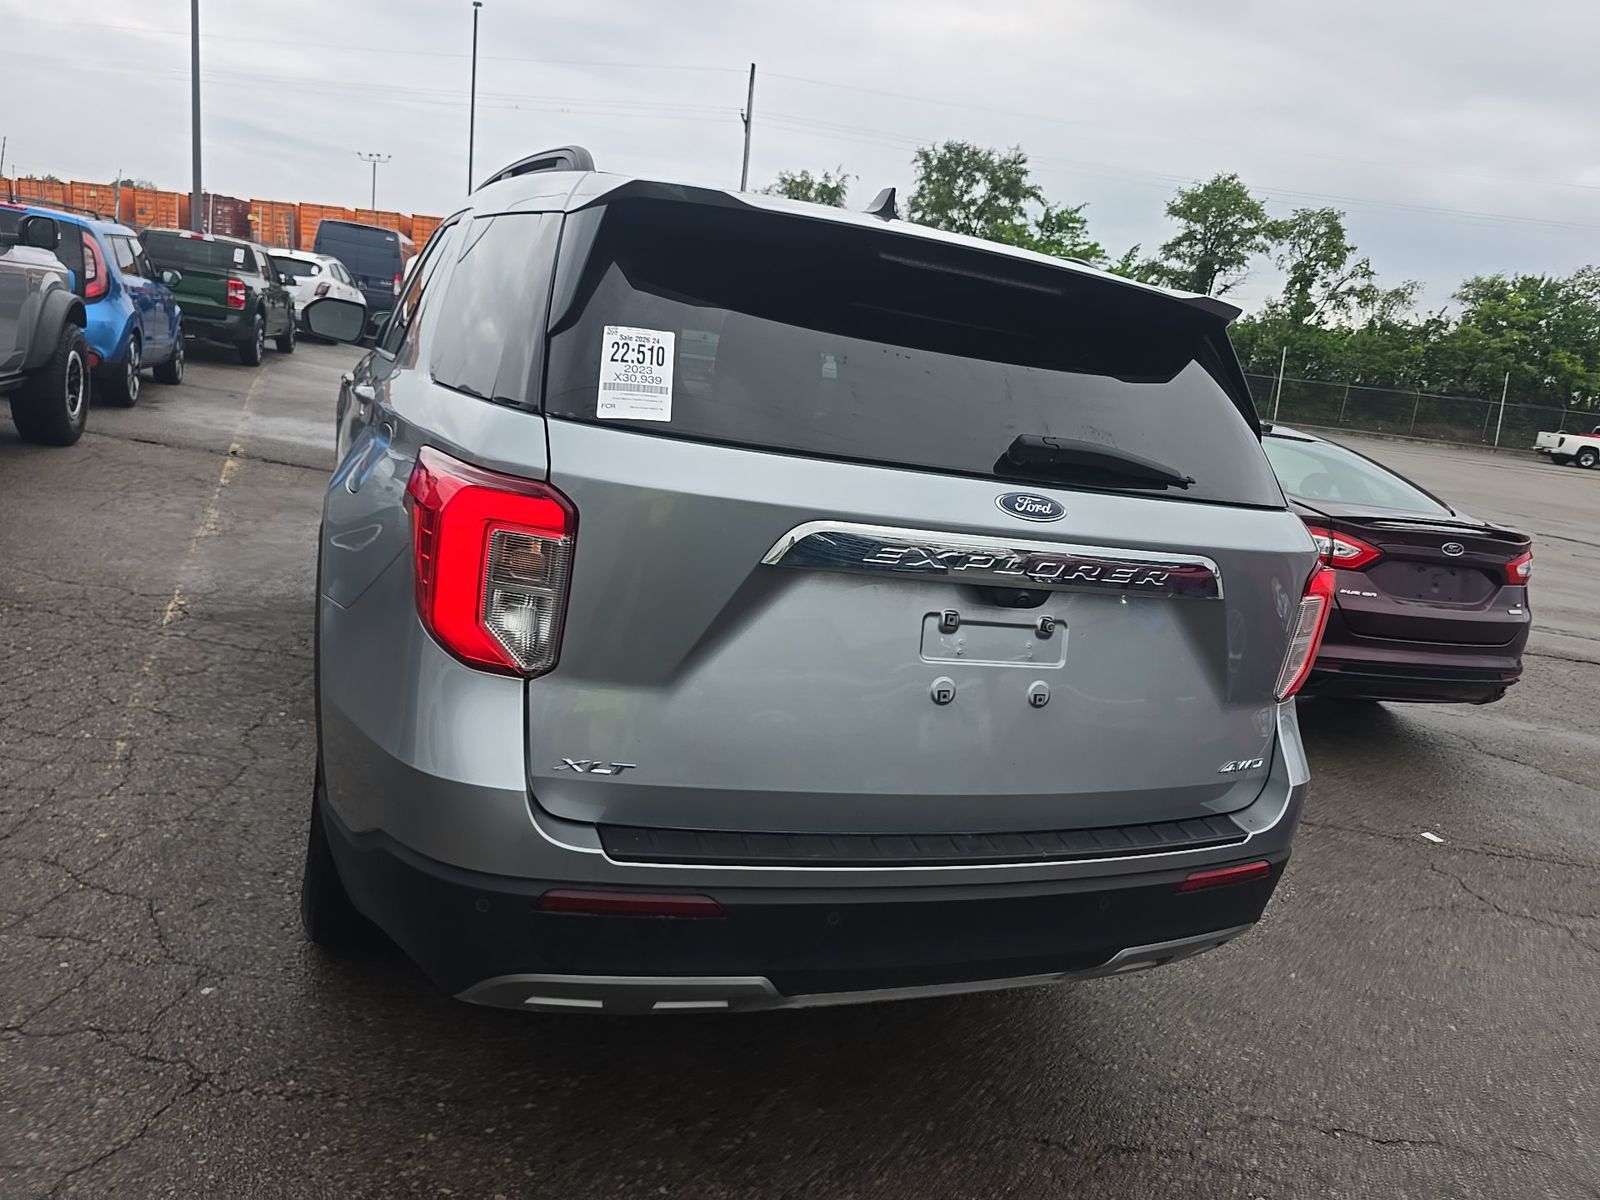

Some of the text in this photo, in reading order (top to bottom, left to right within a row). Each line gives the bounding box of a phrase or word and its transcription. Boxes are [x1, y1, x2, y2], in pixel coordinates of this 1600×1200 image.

[610, 341, 665, 366] 22:510
[624, 365, 653, 374] 2023
[1015, 496, 1053, 514] Ford
[862, 547, 1170, 586] EXPLORER
[552, 757, 638, 776] XLT
